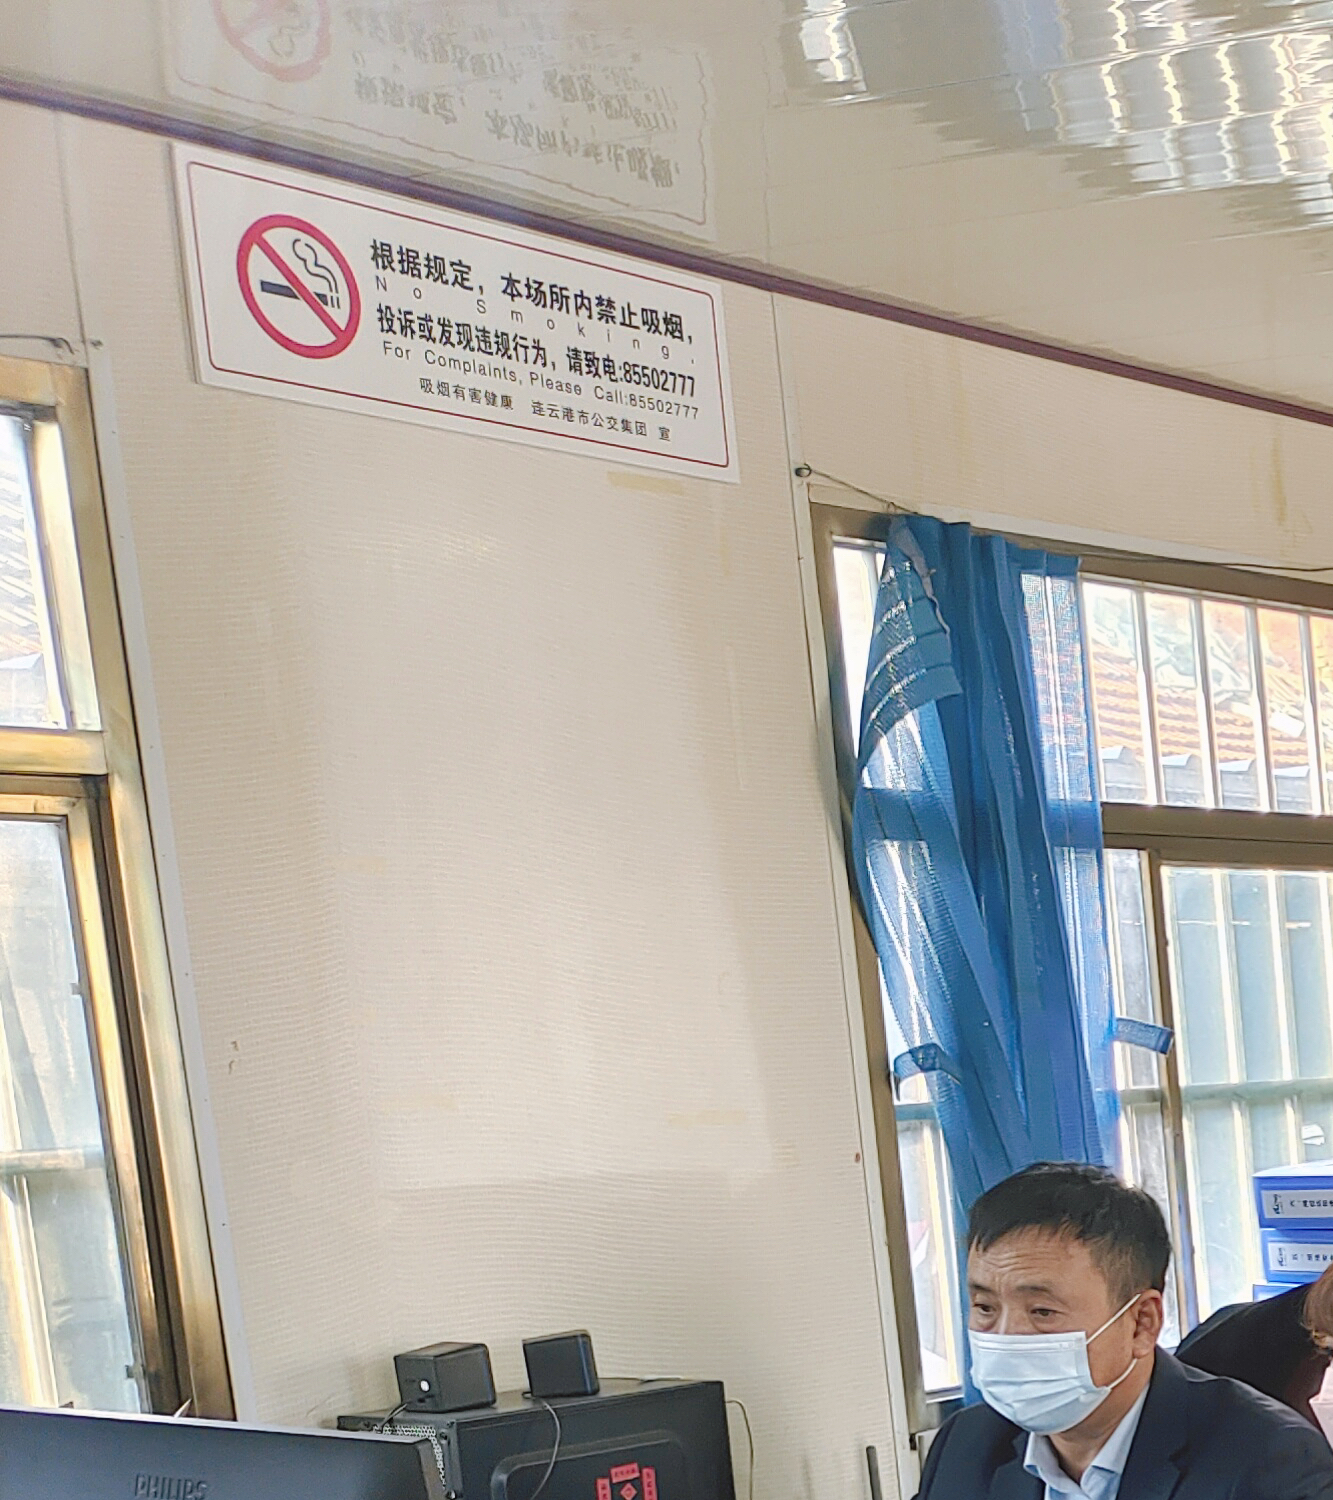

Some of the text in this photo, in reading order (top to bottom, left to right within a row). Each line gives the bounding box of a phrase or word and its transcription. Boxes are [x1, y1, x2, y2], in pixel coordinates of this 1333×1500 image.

[376, 275, 423, 301] No
[383, 340, 701, 422] For Complaints, Please Call:85502777
[418, 376, 514, 413] 吸烟有害健康
[529, 399, 650, 439] 连云港市公交集团
